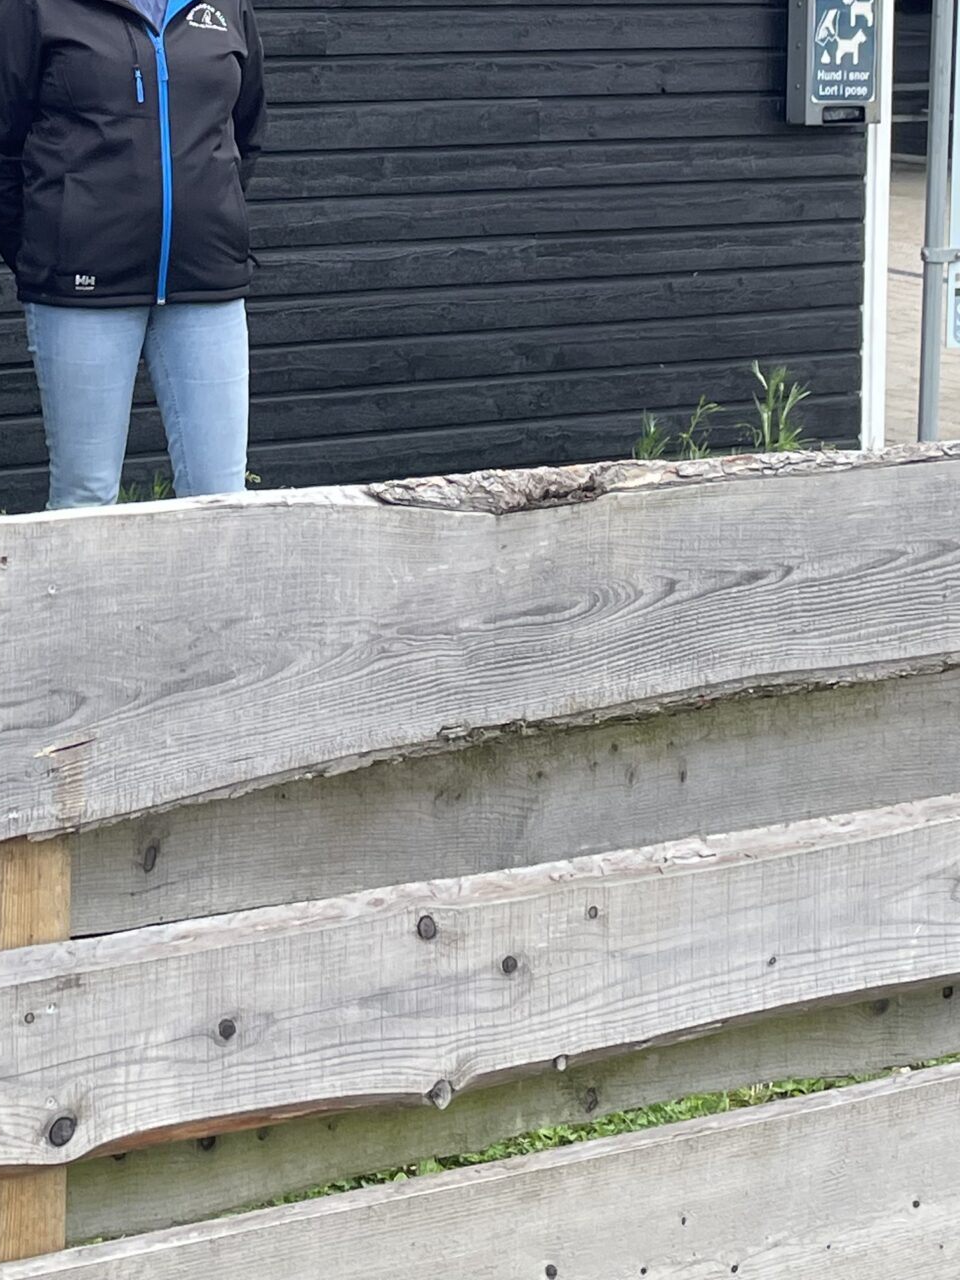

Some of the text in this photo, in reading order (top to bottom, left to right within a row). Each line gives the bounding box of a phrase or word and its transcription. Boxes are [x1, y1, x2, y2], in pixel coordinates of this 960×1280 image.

[817, 70, 842, 81] Hund
[849, 71, 870, 81] snor
[819, 84, 838, 96] Lort
[845, 86, 868, 98] pose
